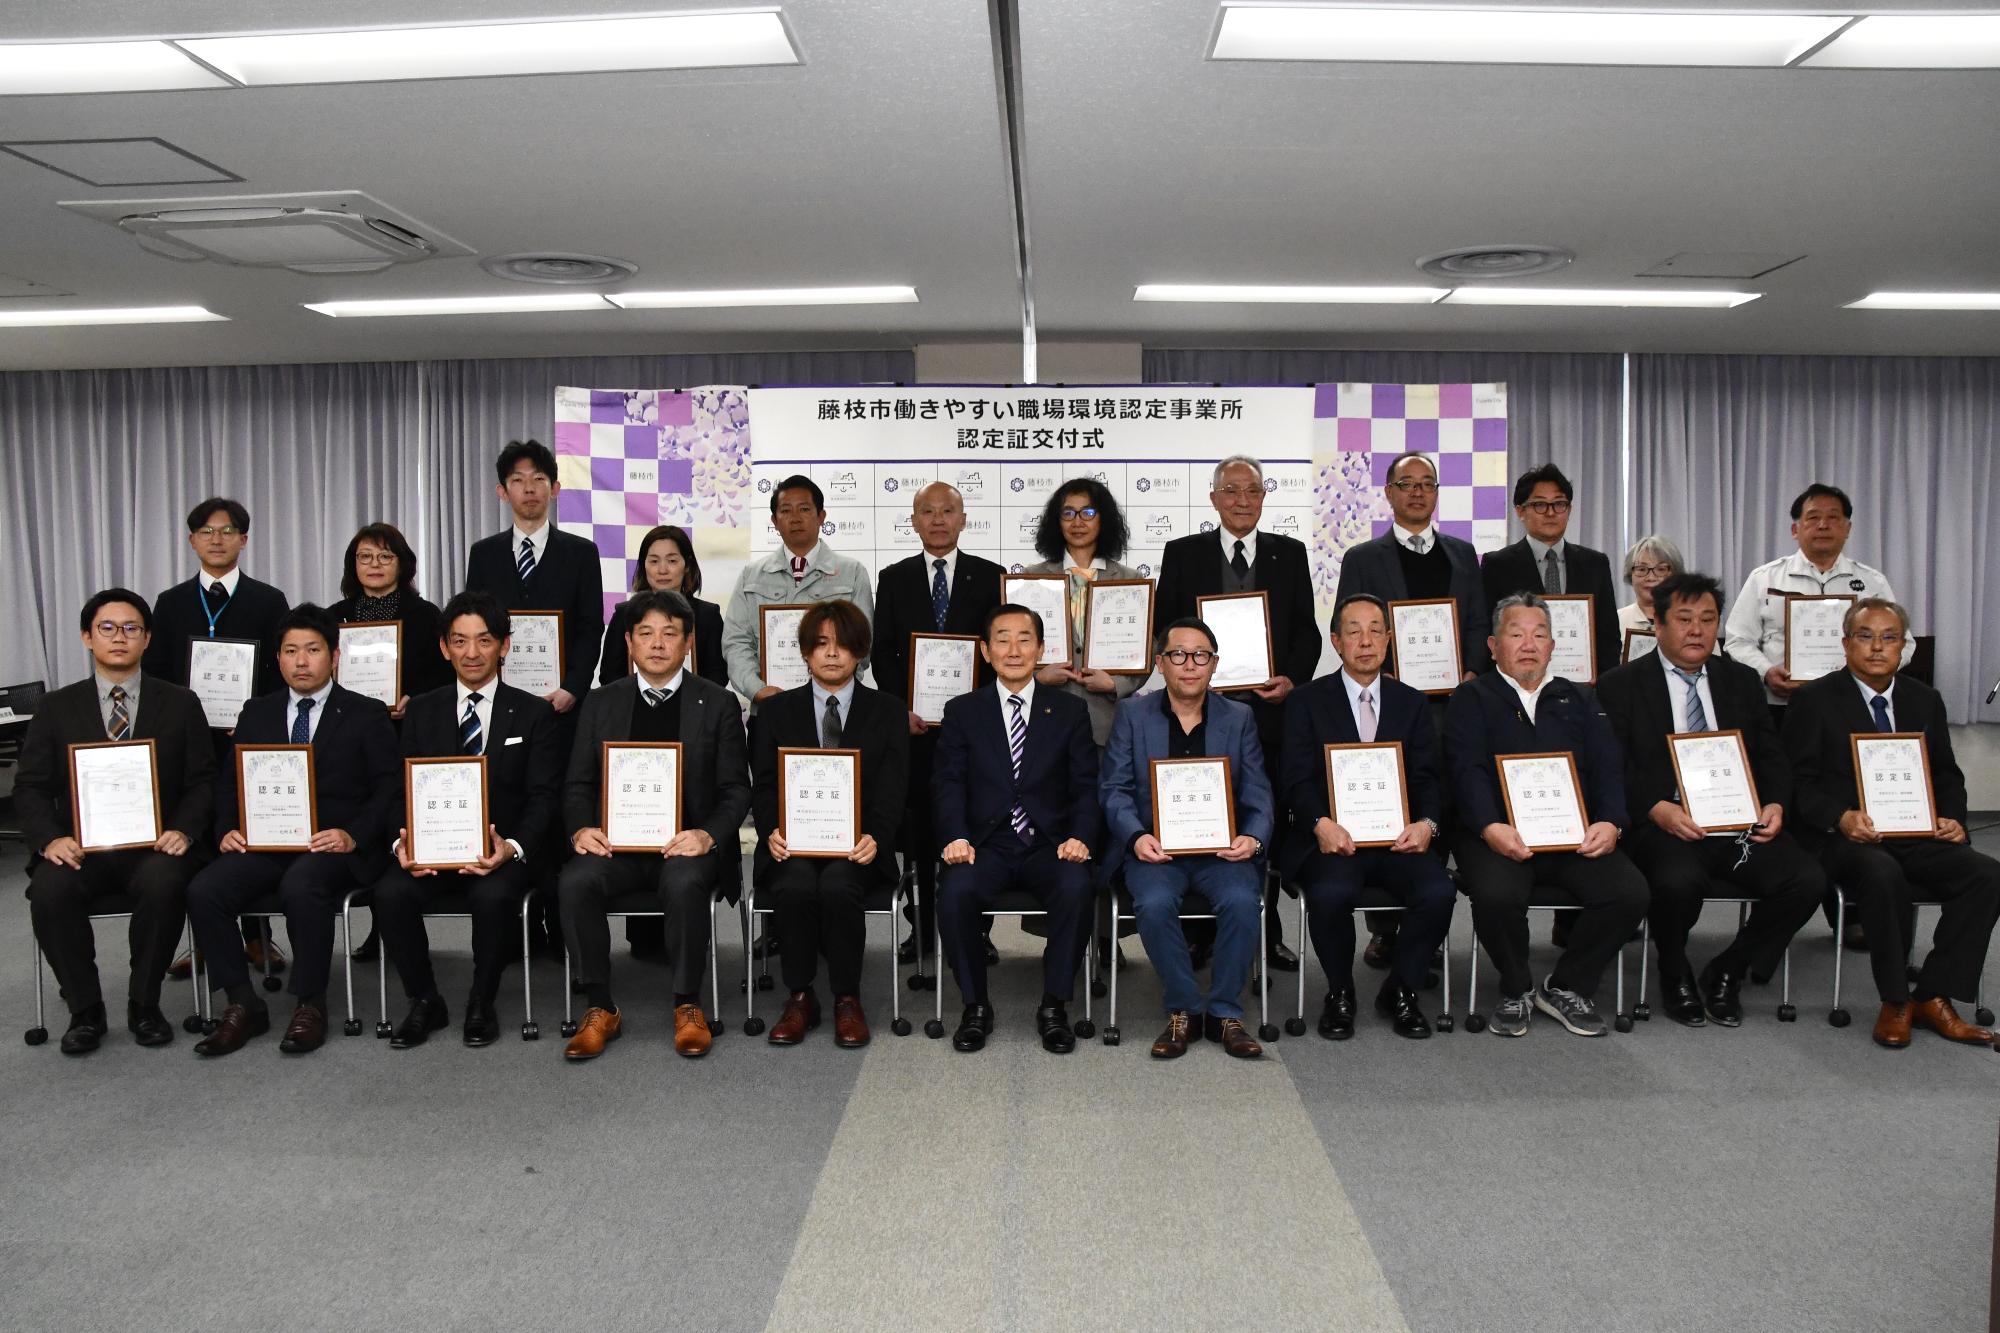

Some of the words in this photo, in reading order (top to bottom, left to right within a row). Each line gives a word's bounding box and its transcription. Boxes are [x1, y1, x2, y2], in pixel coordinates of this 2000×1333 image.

[817, 398, 1243, 421] 藤枝市働きやすい職場環境認定事業所
[957, 427, 1105, 450] 認定証交付式
[629, 471, 654, 480] 藤枝市
[1557, 630, 1578, 638] 定証
[1408, 635, 1442, 644] 認定証
[512, 645, 547, 653] 認定証
[1875, 772, 1912, 782] 認定証
[258, 785, 296, 795] 認定証
[622, 783, 663, 793] 認定証
[1347, 781, 1387, 791] 認定証
[799, 789, 840, 800] 認定証
[1172, 793, 1212, 803] 認定証
[427, 799, 468, 810] 認定証
